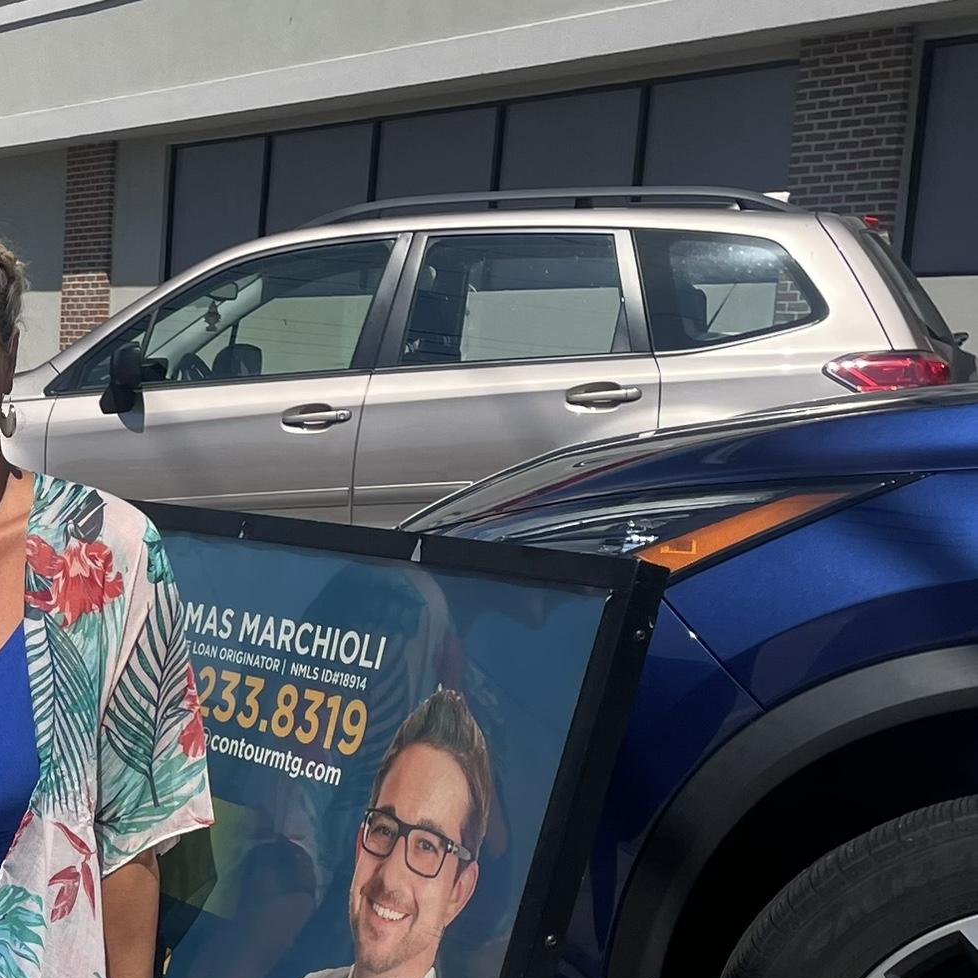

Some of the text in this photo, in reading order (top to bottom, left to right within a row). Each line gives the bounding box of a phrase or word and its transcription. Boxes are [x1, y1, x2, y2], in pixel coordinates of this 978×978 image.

[182, 601, 387, 670] MAS MARCHIOLI
[192, 641, 219, 659] LOAN
[219, 647, 281, 673] ORIGINATOR
[290, 662, 320, 681] NMLS
[321, 668, 368, 692] ID#18914
[199, 665, 368, 757] 233.8319
